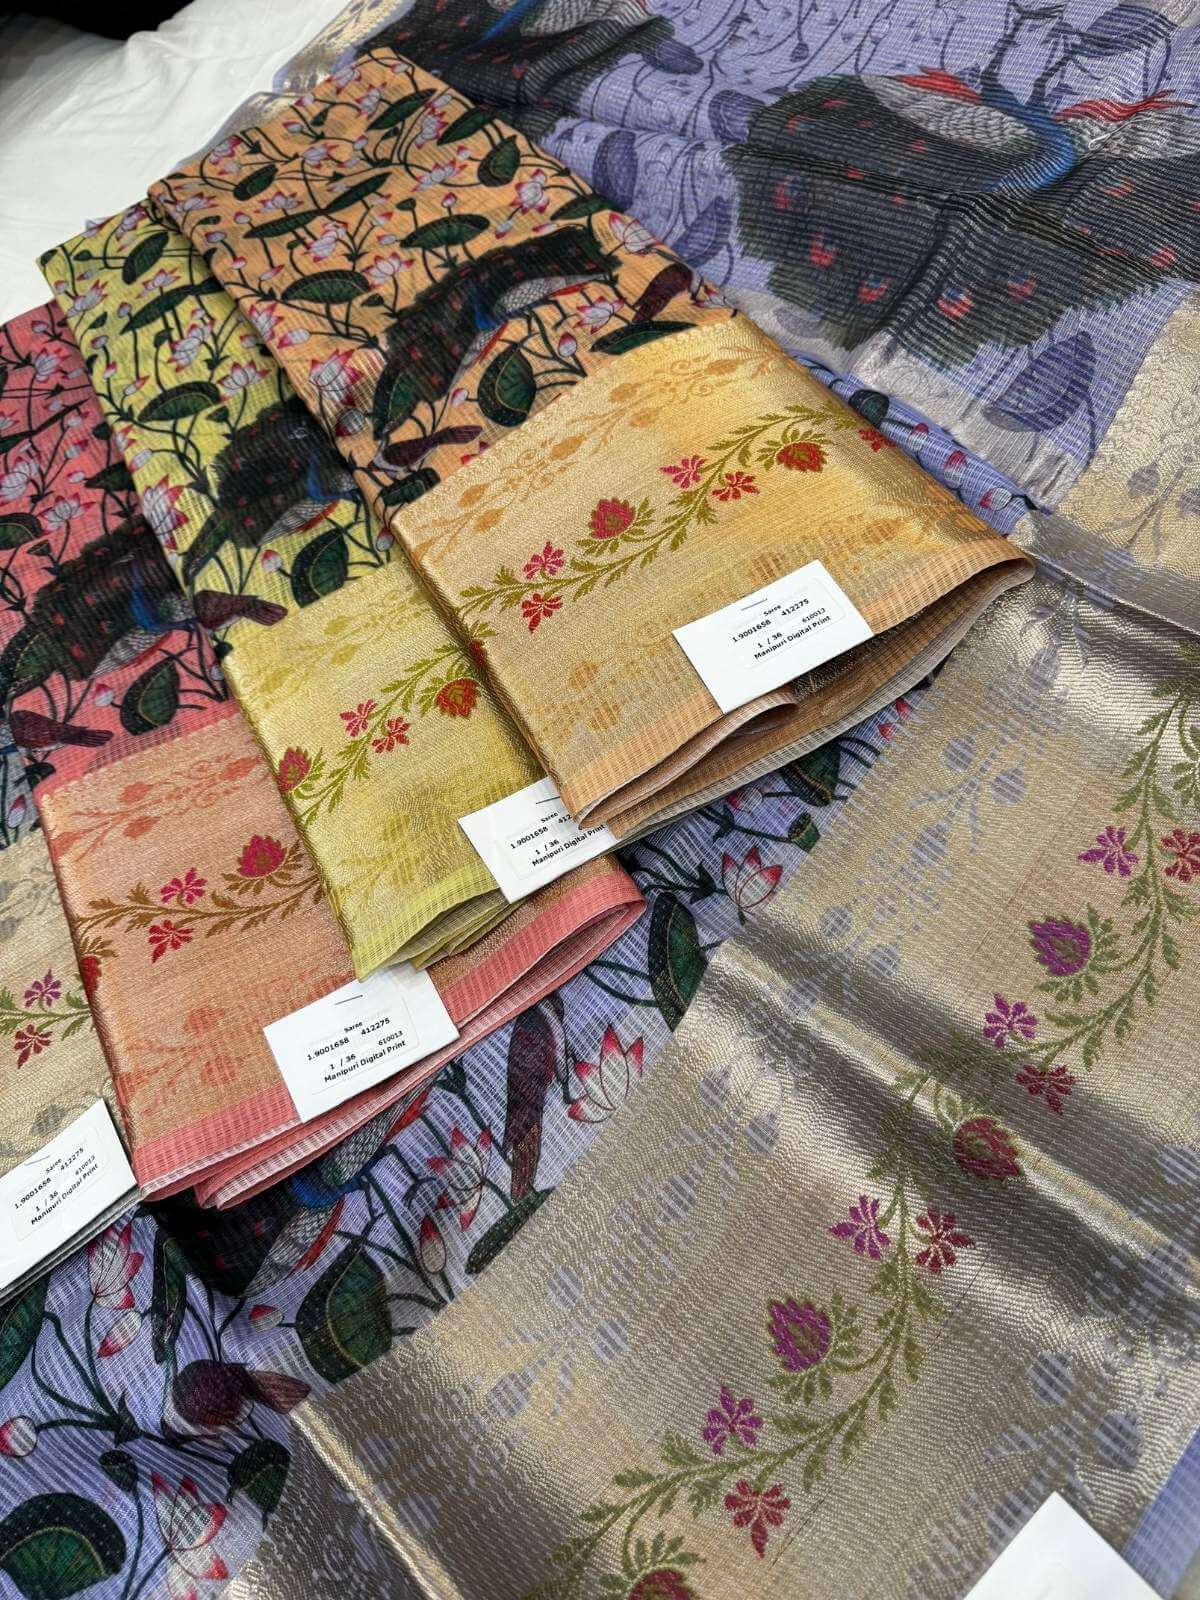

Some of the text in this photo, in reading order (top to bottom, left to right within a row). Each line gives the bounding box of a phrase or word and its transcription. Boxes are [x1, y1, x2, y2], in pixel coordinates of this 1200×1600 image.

[732, 598, 809, 643] 1.9001658 412275
[764, 605, 781, 616] Saree
[754, 615, 831, 659] Manipuri Digital Print
[772, 632, 782, 641] 36
[511, 815, 572, 849] 1.9001658 412
[541, 812, 558, 823] Saree
[532, 824, 605, 866] Manipuri Digital Print
[307, 1017, 390, 1061] 1.9001658 412275
[344, 1021, 363, 1033] Saree
[324, 1040, 406, 1083] Manipuri Digital Print
[346, 1054, 356, 1063] 36
[46, 1158, 62, 1173] Saree
[60, 1147, 84, 1171] 412275
[31, 1164, 98, 1225] Manipuri Digital Print
